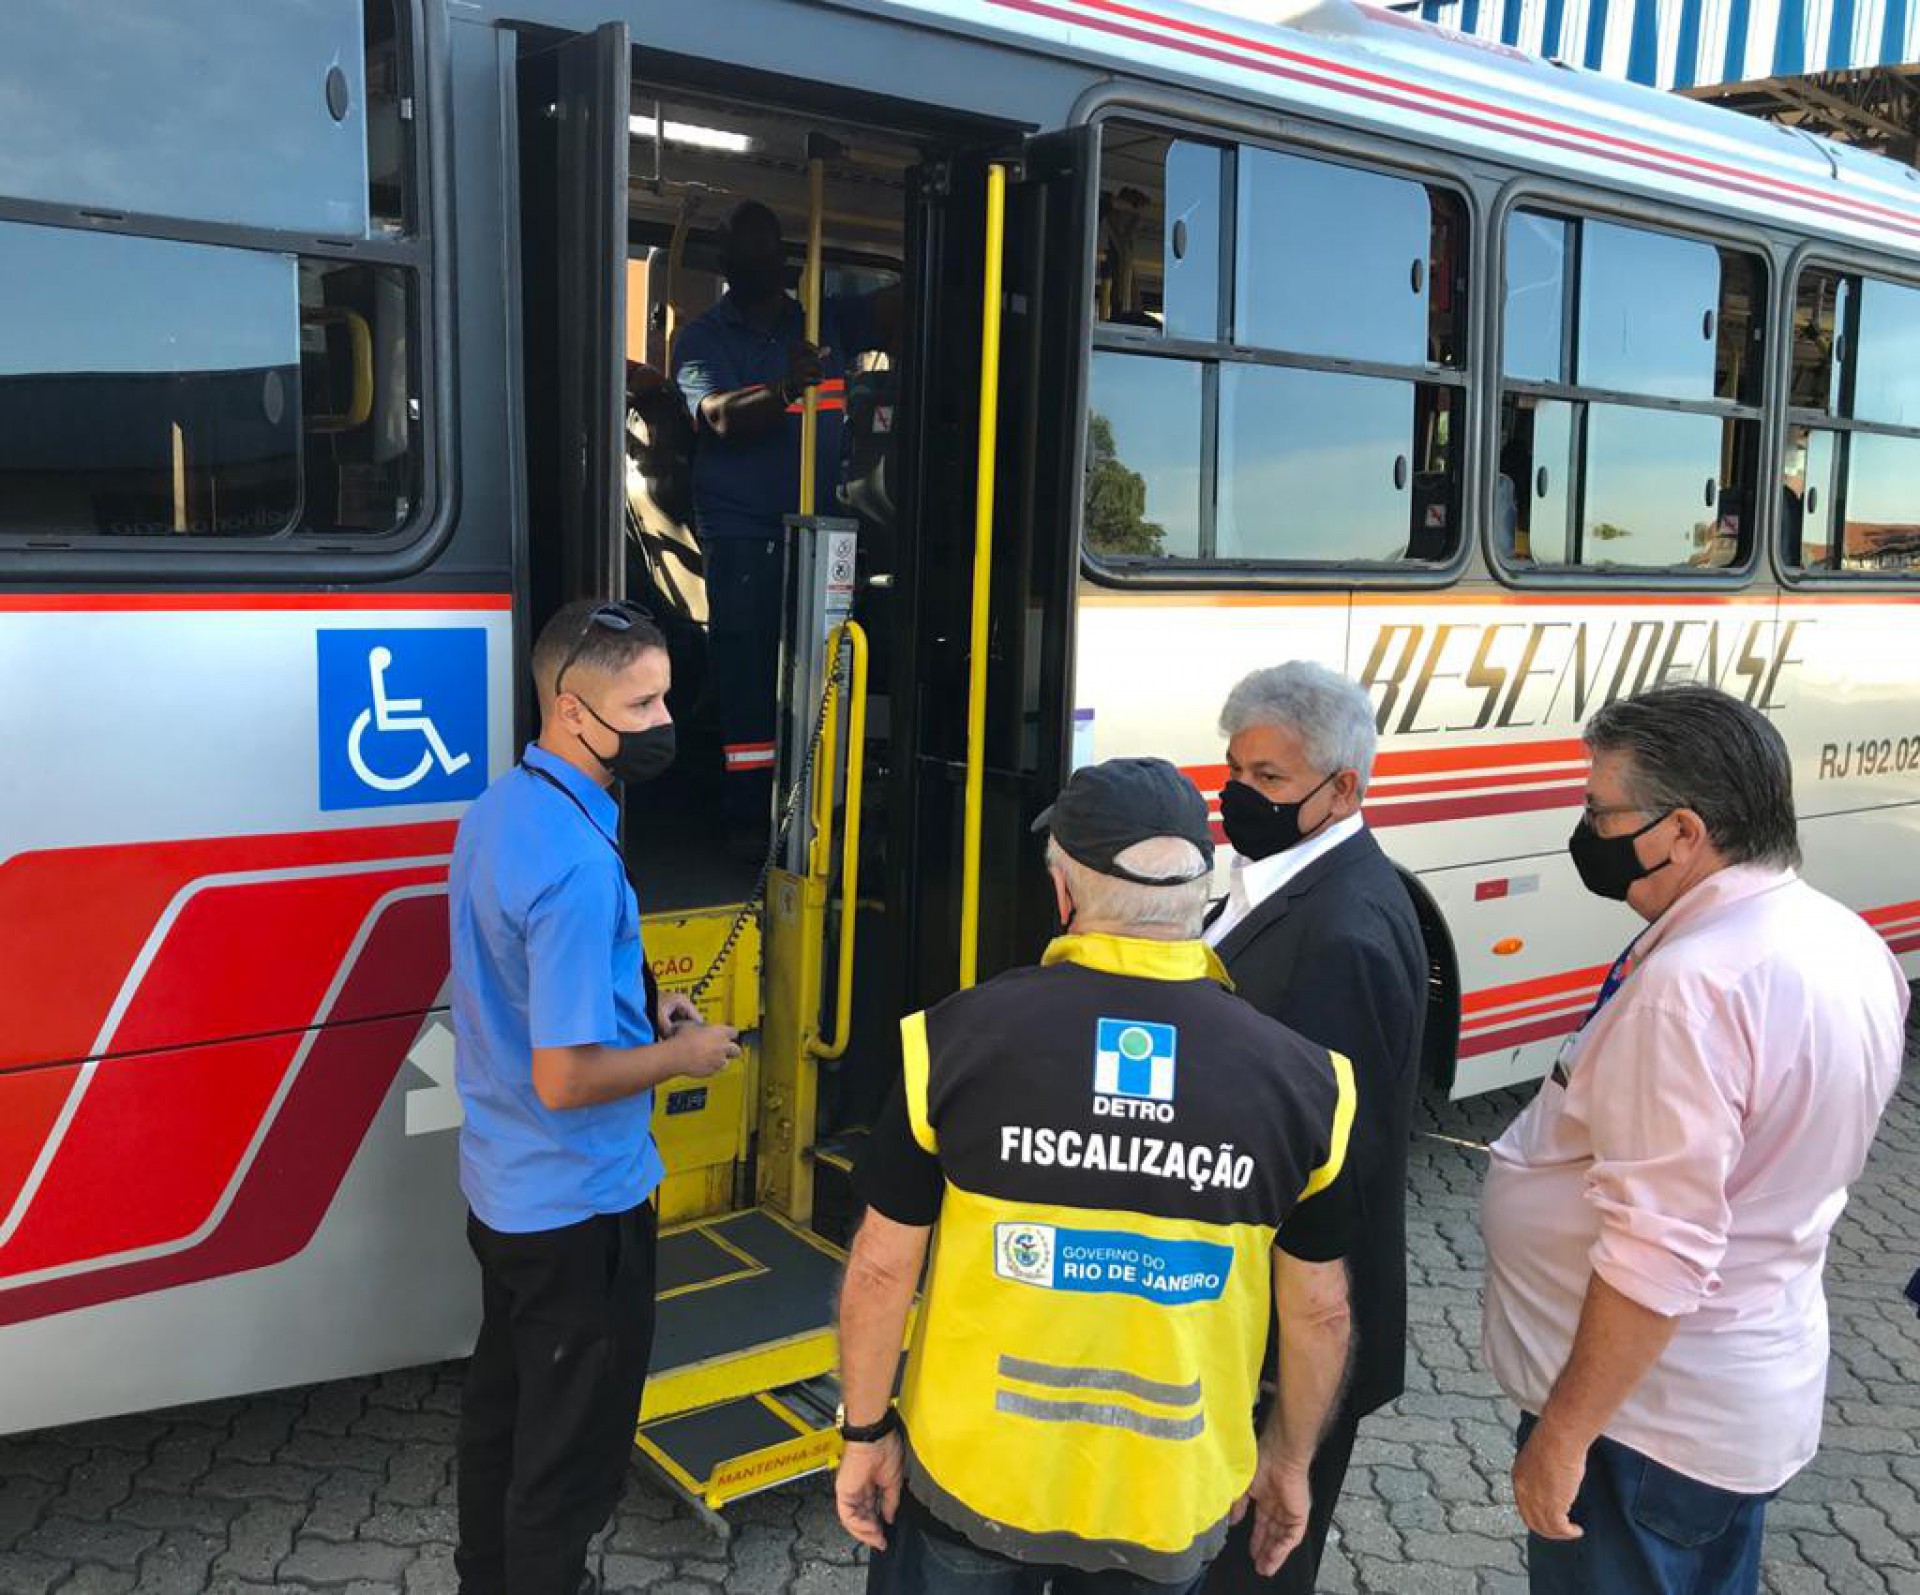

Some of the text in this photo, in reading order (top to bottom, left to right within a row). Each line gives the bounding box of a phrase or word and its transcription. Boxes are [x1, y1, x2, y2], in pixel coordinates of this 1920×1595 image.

[1360, 618, 1818, 736] RESENDENSE
[1819, 742, 1851, 780] RJ
[1093, 1096, 1175, 1124] DETRO
[1000, 1125, 1255, 1192] FISCALIZAÇÃO
[1062, 1246, 1165, 1270] GOVERNO DO
[1063, 1262, 1220, 1292] RIO DE JANEIRO
